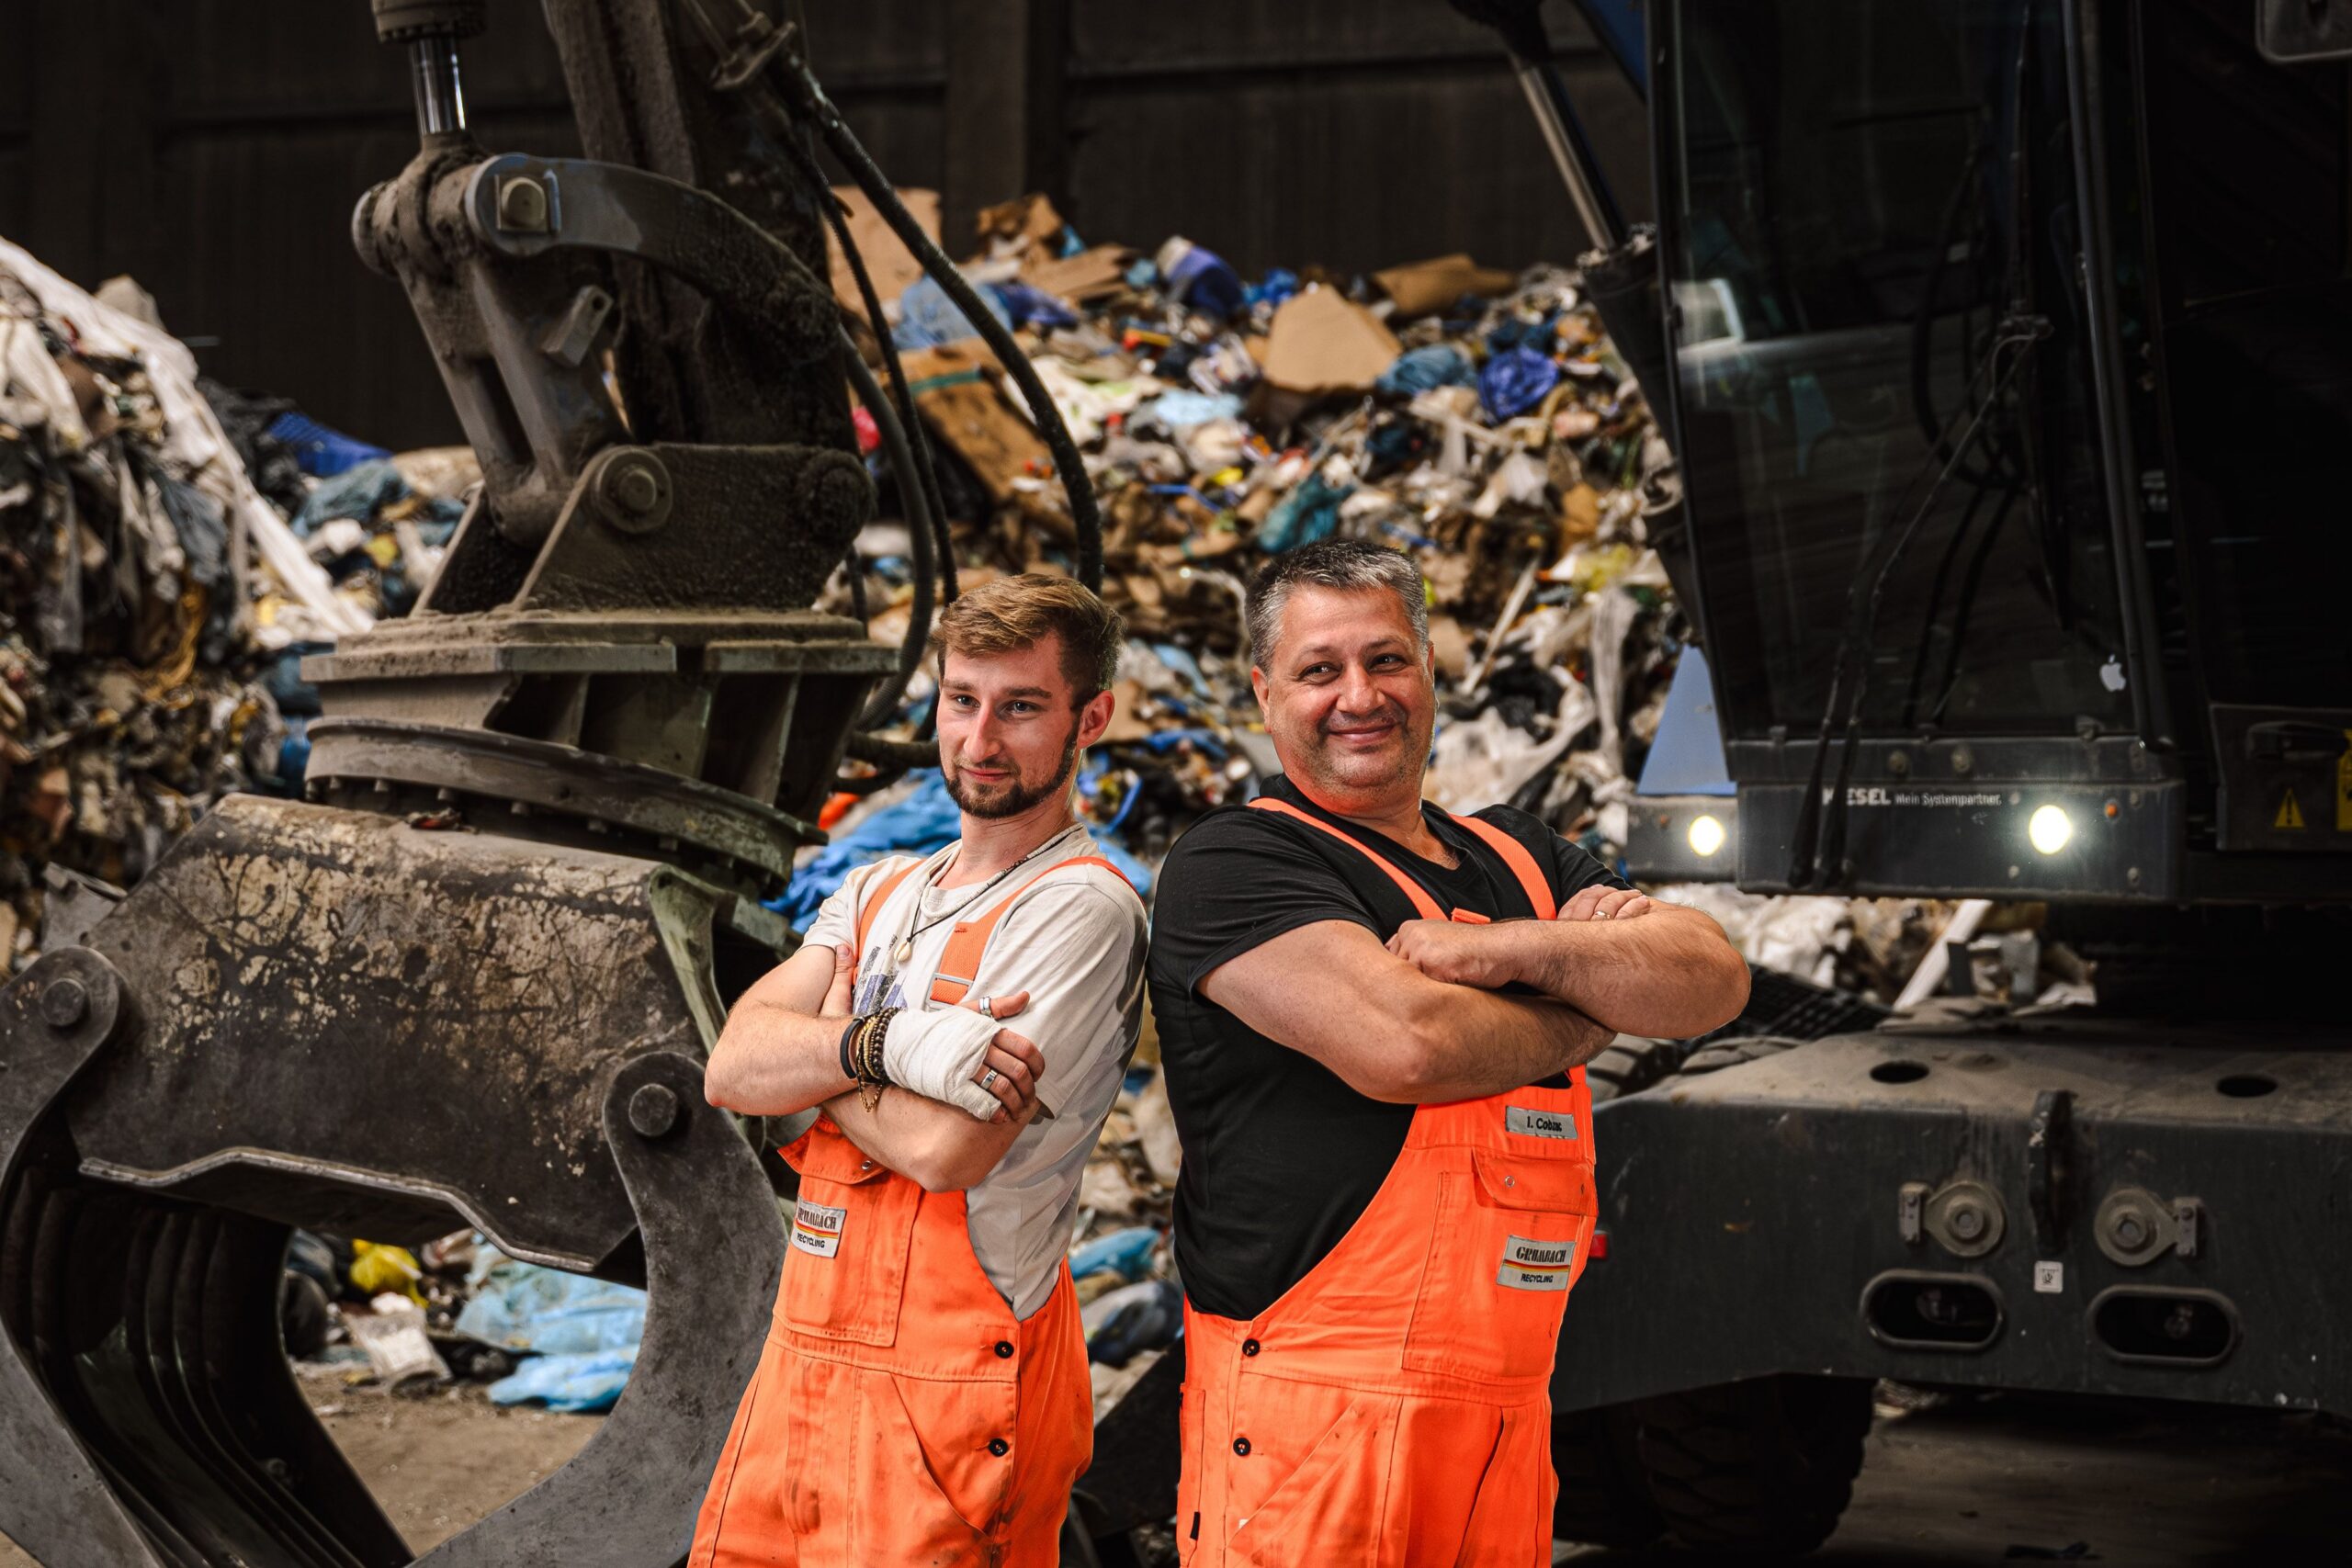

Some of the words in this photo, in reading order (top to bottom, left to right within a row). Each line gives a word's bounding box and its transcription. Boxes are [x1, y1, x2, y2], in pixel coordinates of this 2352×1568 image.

[1822, 787, 1892, 806] KESEL
[1894, 794, 1920, 806] Mein
[797, 1233, 825, 1248] RECYCLING
[1521, 1273, 1554, 1283] RECYCLING
